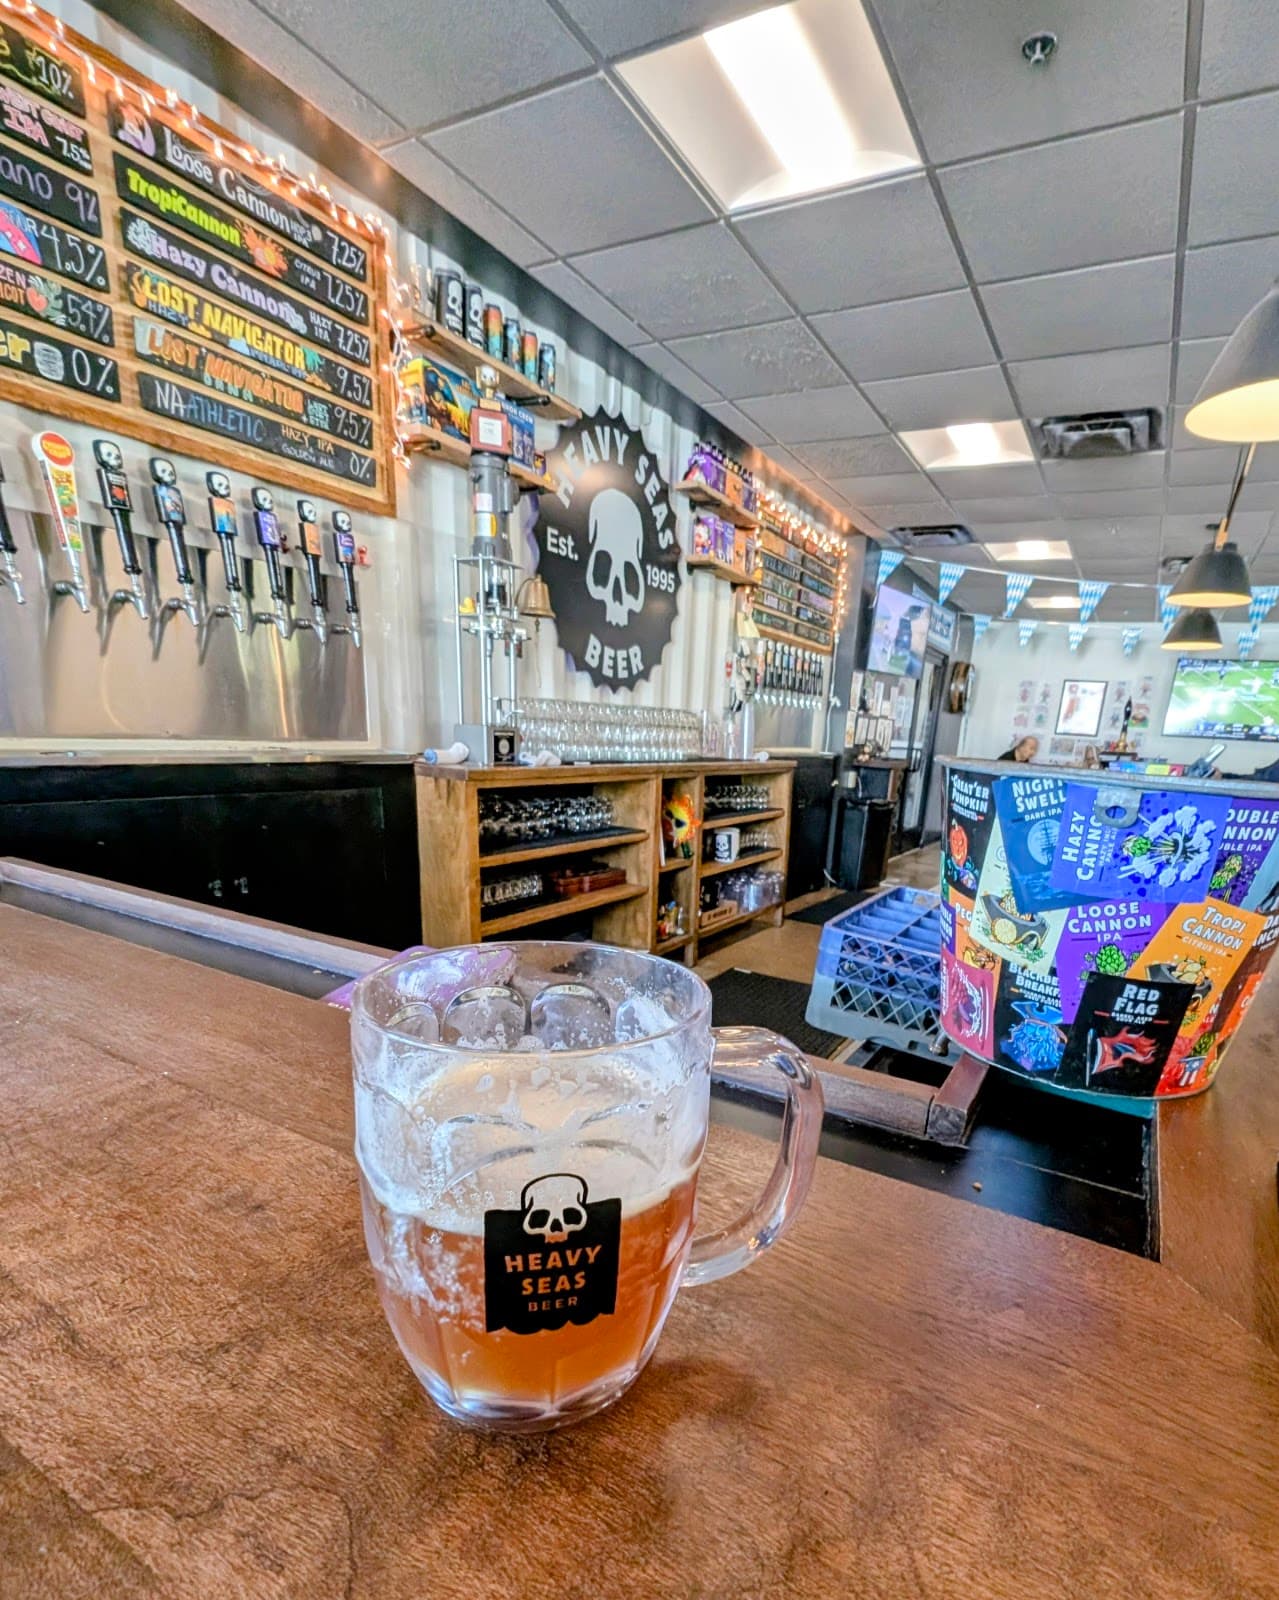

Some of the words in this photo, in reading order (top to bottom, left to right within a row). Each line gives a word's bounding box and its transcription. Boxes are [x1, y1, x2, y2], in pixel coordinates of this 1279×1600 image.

[36, 55, 74, 99] 10%
[163, 126, 214, 184] Loose
[219, 168, 290, 233] Cannon
[65, 182, 98, 223] 9%
[41, 225, 105, 286] 4.5%
[326, 230, 366, 275] 7.25%
[151, 232, 207, 278] Hazy
[210, 264, 291, 318] Cannon
[143, 276, 200, 319] LOST
[203, 301, 306, 371] NAVIGATOR
[309, 311, 332, 331] HAZY
[335, 324, 370, 363] 7.25%
[72, 349, 113, 393] 0%
[149, 327, 200, 369] LOST
[206, 353, 304, 413] NAVIGATOR
[337, 366, 370, 406] 9.5%
[186, 393, 264, 442] ATHLETIC
[334, 406, 370, 446] 9.5%
[281, 424, 310, 449] HAZY
[317, 439, 335, 456] IPA
[350, 452, 371, 479] 0%
[556, 425, 630, 509] HEAVY
[635, 454, 674, 549] SEAS
[546, 526, 579, 561] Est.
[646, 564, 675, 593] 1995
[584, 633, 644, 679] BEER
[952, 787, 988, 814] PUMPKIN
[1015, 790, 1066, 813] SWELL
[1024, 810, 1046, 822] DARK
[1047, 807, 1062, 817] IPA
[1062, 811, 1086, 862] HAZY
[1223, 825, 1277, 841] NNON
[1246, 843, 1262, 852] IPA
[1068, 914, 1152, 933] CANNON
[1077, 901, 1140, 918] LOOSE
[1202, 906, 1247, 933] TROPI
[1097, 932, 1122, 943] IPA
[1181, 936, 1213, 953] CITRUS
[1182, 918, 1244, 950] CANNON
[1113, 996, 1160, 1016] FLAG
[1122, 983, 1160, 1002] RED
[504, 1245, 602, 1273] HEAVY
[521, 1271, 586, 1295] SEAS
[528, 1296, 578, 1312] BEER
